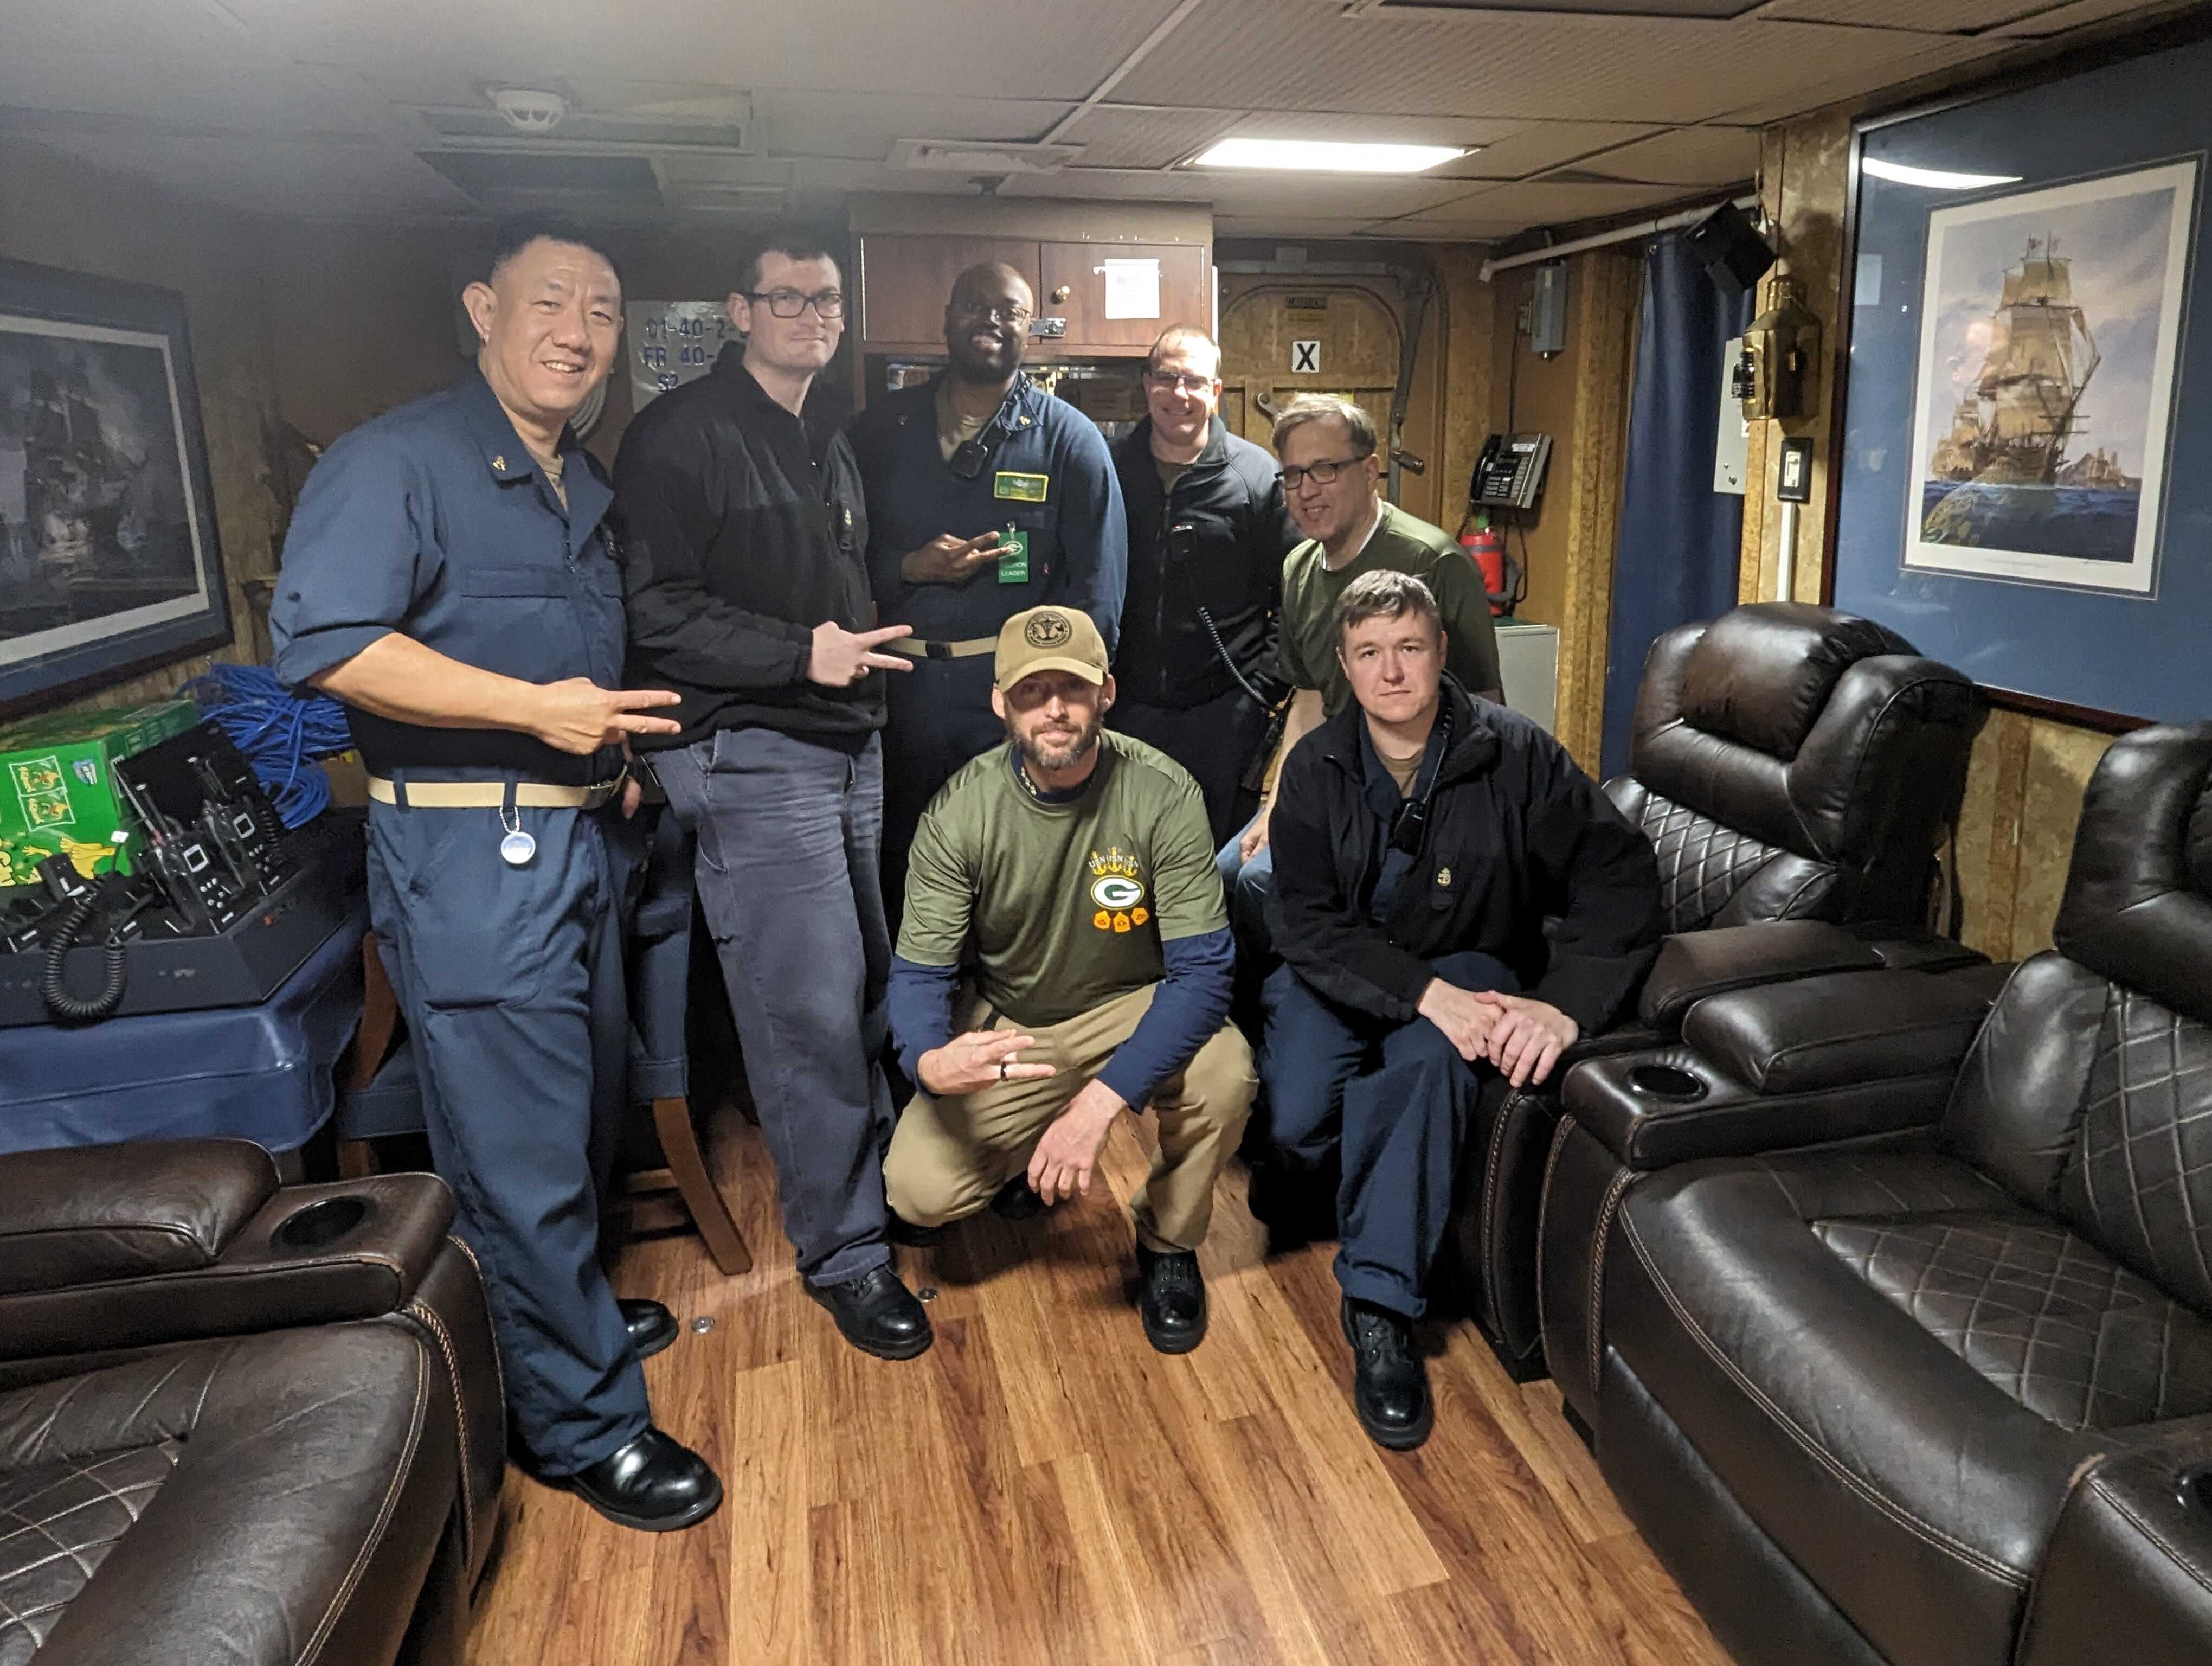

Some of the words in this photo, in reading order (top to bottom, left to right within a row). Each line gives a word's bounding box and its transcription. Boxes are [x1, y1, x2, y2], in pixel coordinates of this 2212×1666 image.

[644, 347, 666, 367] FR
[1296, 343, 1316, 370] X
[1107, 855, 1123, 863] USN
